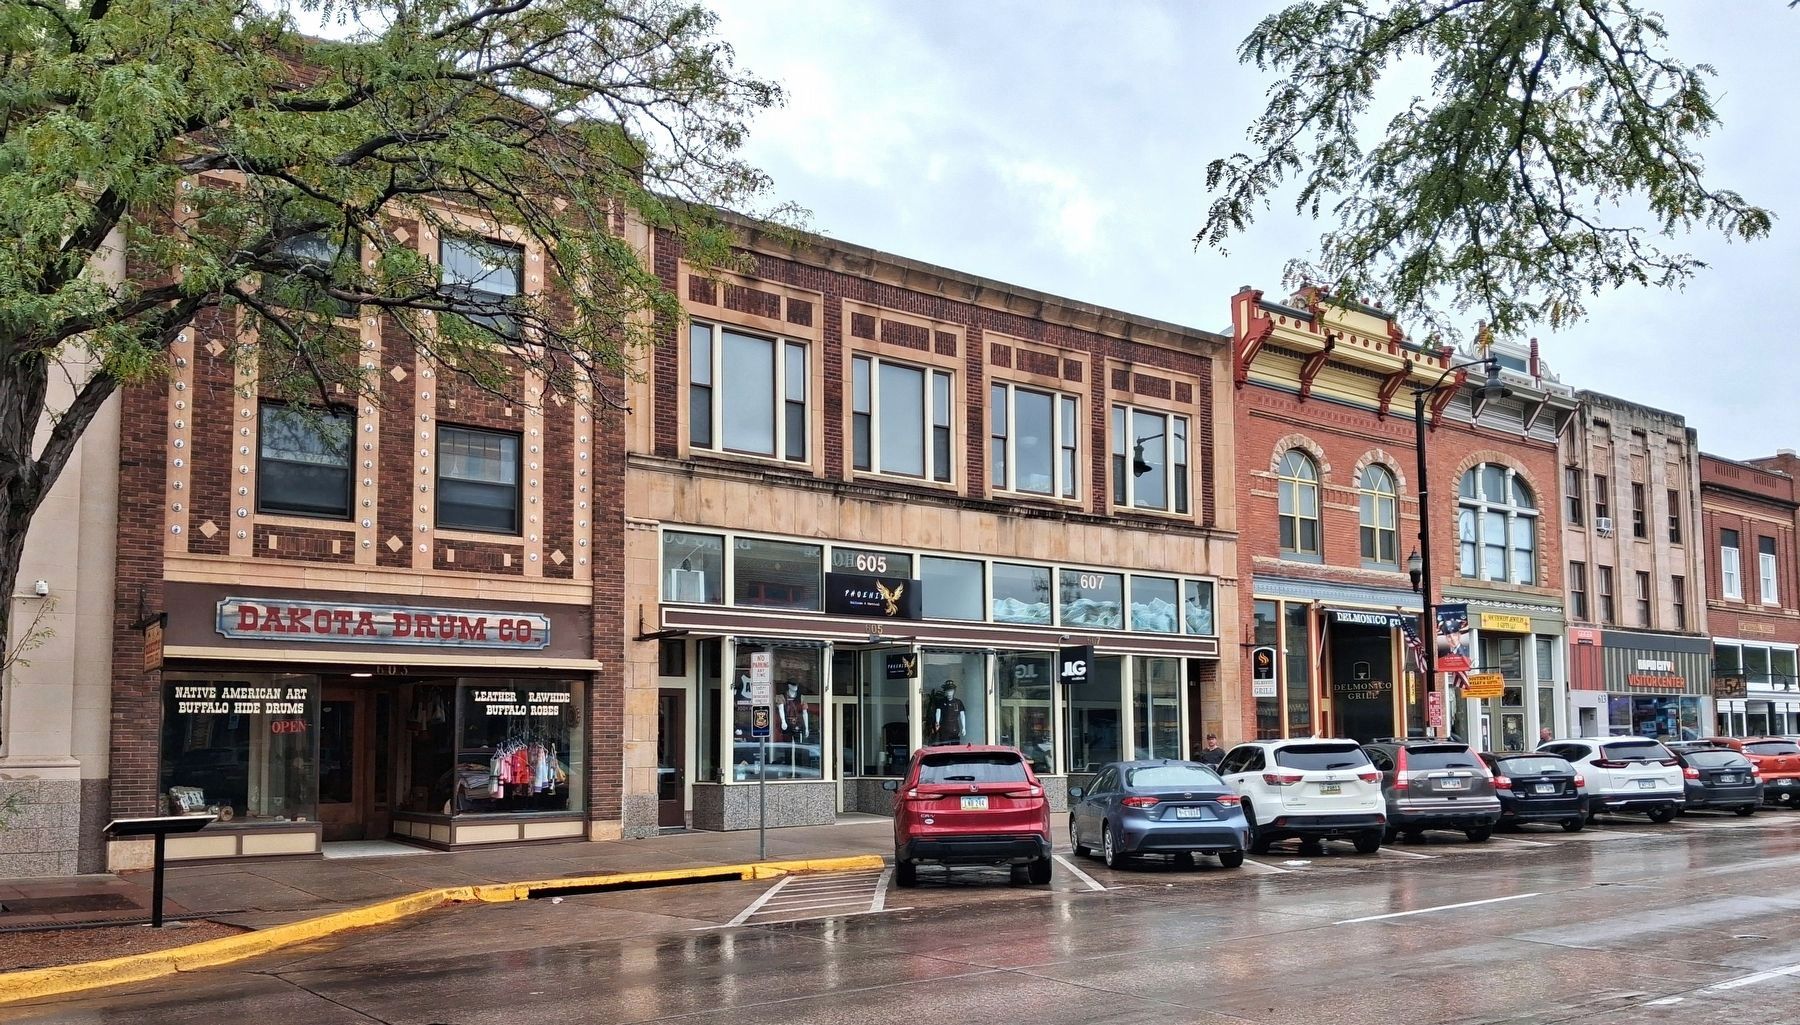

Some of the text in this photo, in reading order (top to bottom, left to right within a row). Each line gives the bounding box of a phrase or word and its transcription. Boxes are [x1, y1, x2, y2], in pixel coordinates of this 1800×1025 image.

[856, 555, 887, 573] 605
[1080, 575, 1104, 590] 607
[237, 605, 541, 643] DAKOTA DRUM CO.
[1337, 611, 1387, 625] DELMONICO
[1334, 682, 1392, 691] DELMONICO
[1628, 674, 1685, 688] VISITOR CENTER
[175, 687, 307, 699] NATIVE AMERICAN ART
[475, 691, 570, 703] LEATHER RAWHIDE
[1254, 687, 1273, 695] GRILL
[1347, 692, 1379, 700] GRILL
[1598, 695, 1606, 703] 613
[179, 702, 304, 714] BUFFALO HIDE DRUMS
[486, 705, 559, 715] BUFFALO ROBES
[271, 720, 306, 733] OPEN
